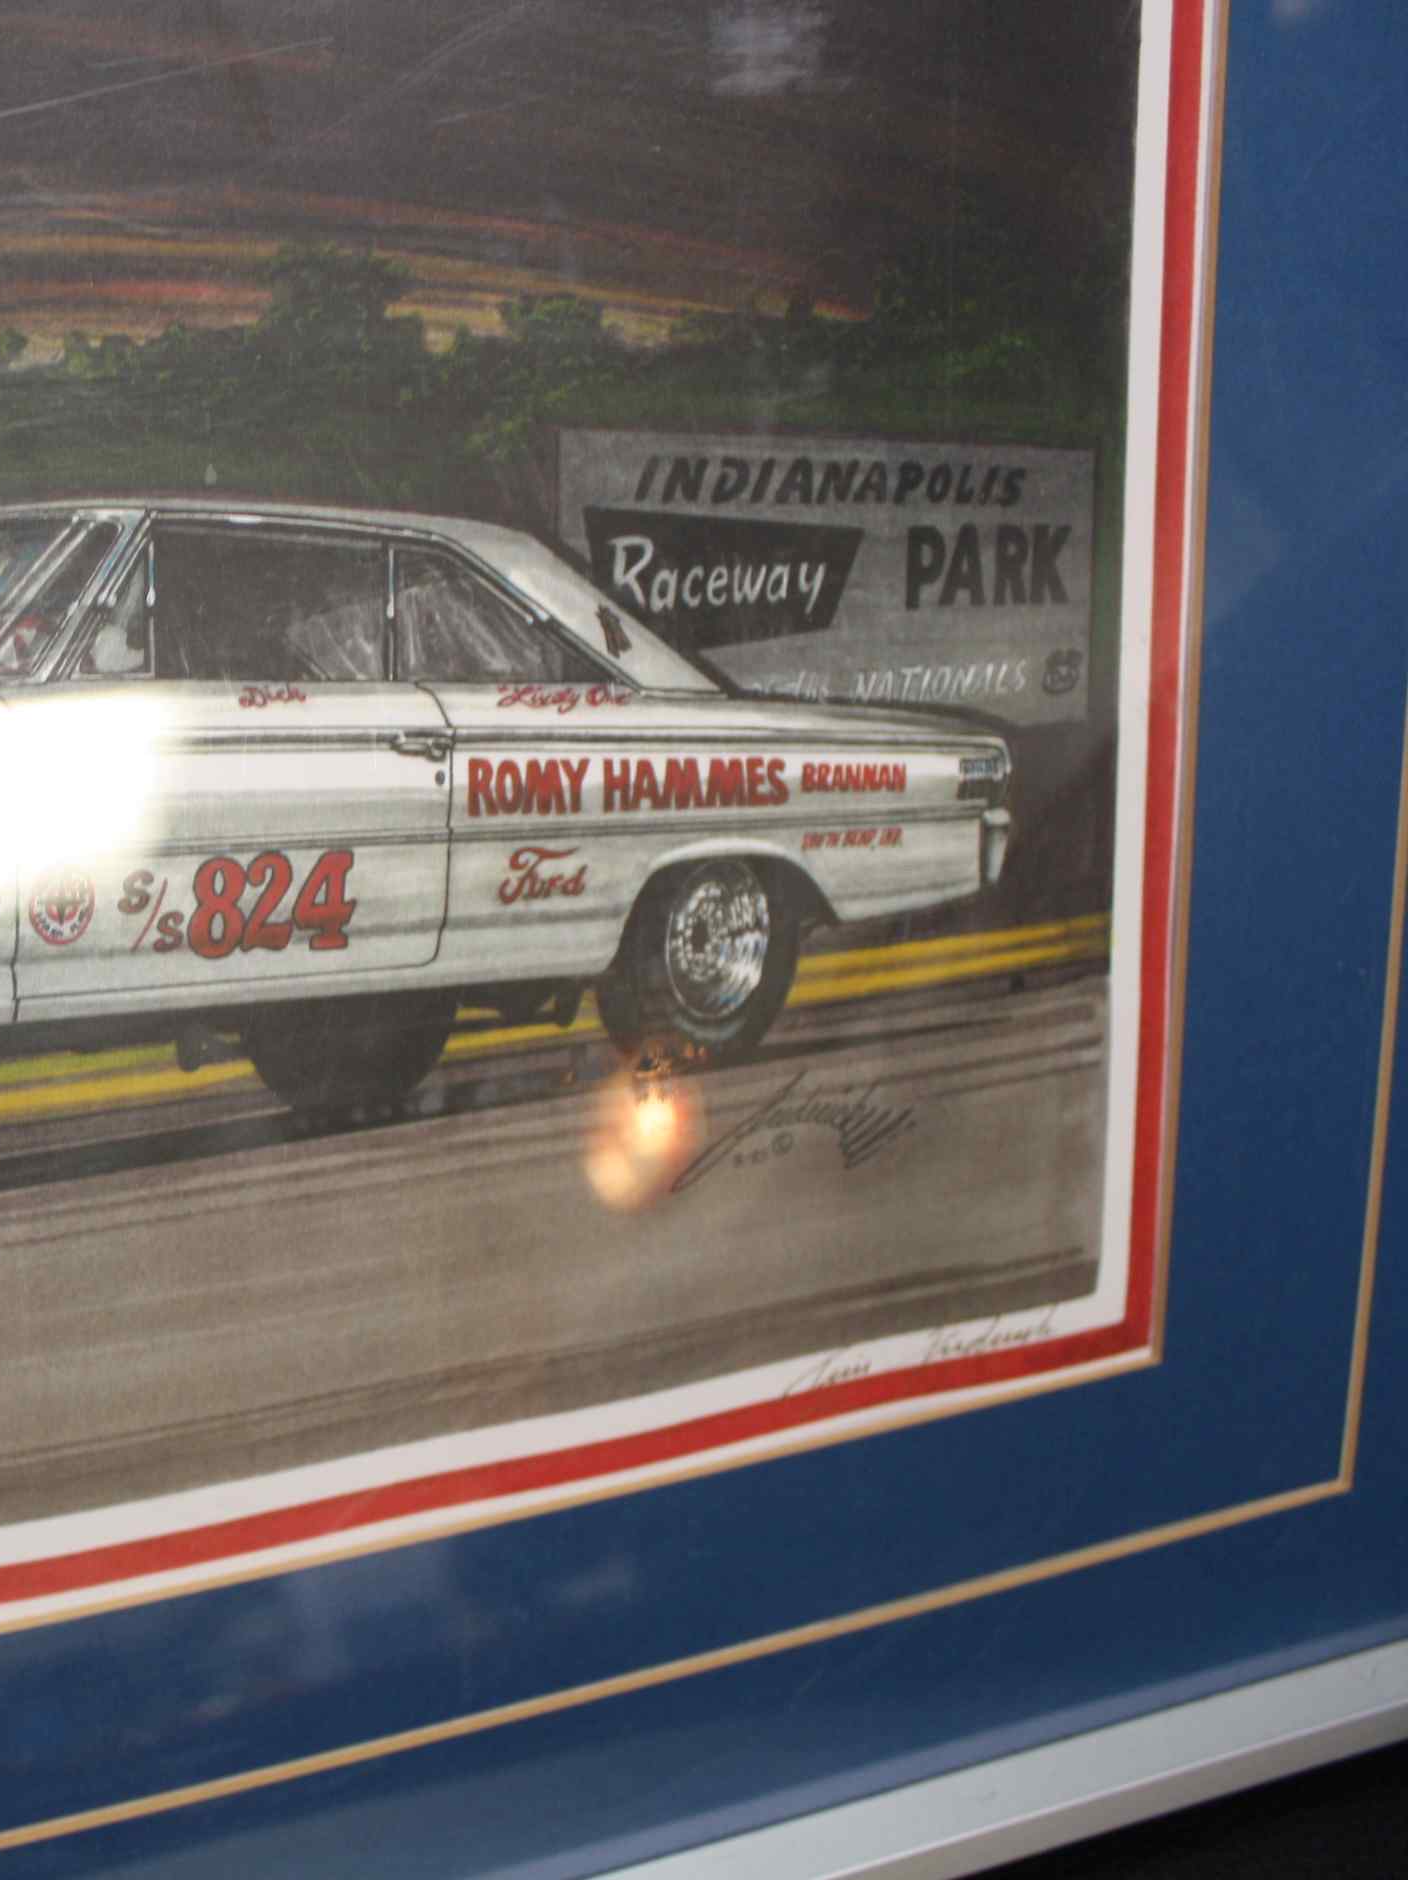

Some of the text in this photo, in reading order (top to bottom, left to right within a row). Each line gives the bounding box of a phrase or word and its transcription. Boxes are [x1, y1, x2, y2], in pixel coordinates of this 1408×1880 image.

[635, 455, 1026, 507] INDIANAPOLIS
[608, 535, 827, 616] Raceway
[904, 523, 1073, 610] PARK
[467, 756, 791, 819] ROMY HAMMES
[800, 762, 909, 795] BRANNAN
[187, 849, 358, 959] 824
[498, 845, 589, 907] Ford
